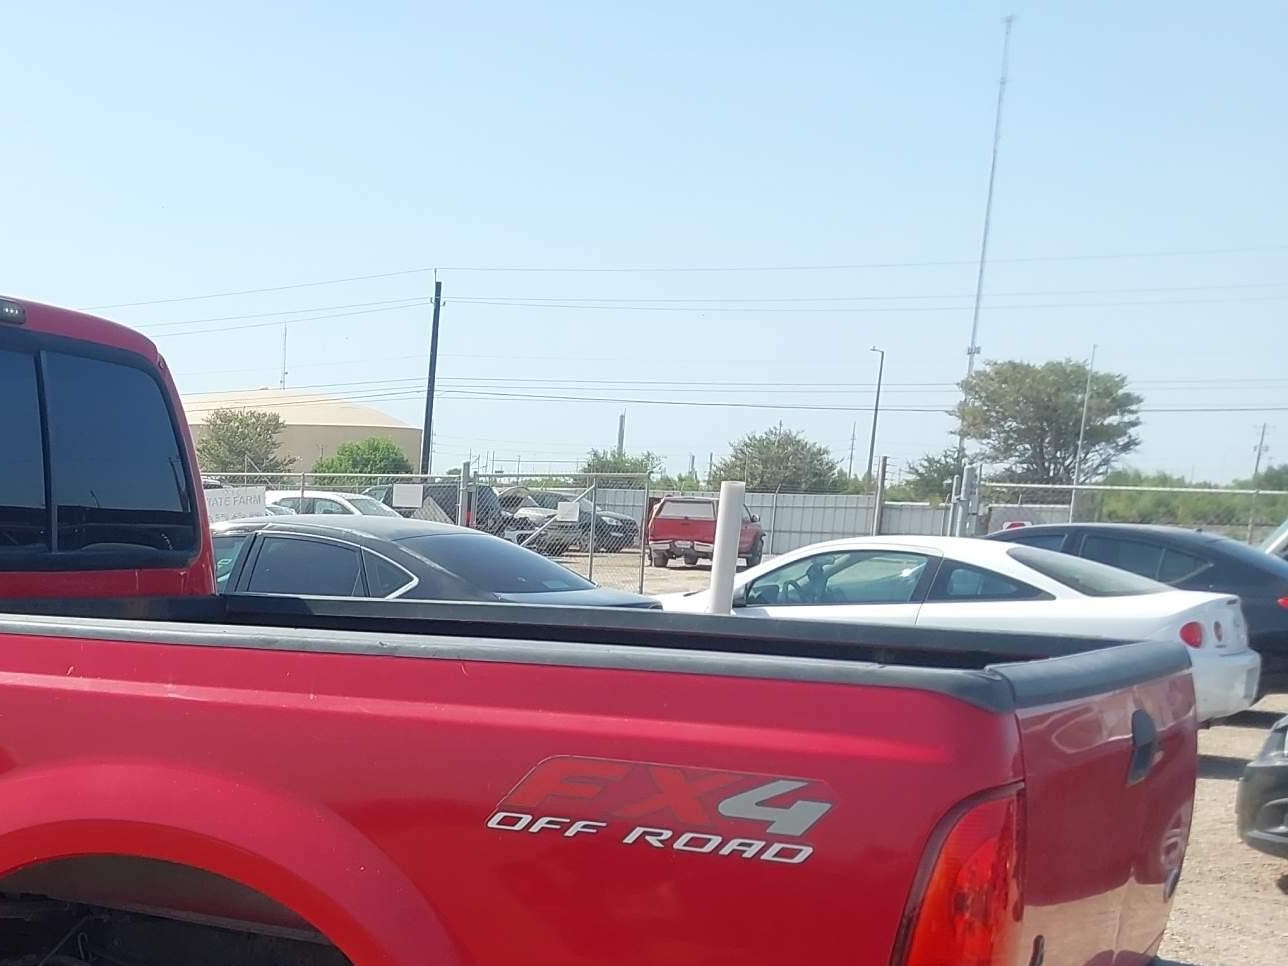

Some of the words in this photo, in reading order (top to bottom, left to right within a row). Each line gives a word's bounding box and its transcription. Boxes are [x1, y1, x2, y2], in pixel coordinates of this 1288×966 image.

[509, 759, 833, 837] FX4
[487, 811, 607, 837] OFF
[622, 826, 814, 864] ROAD
